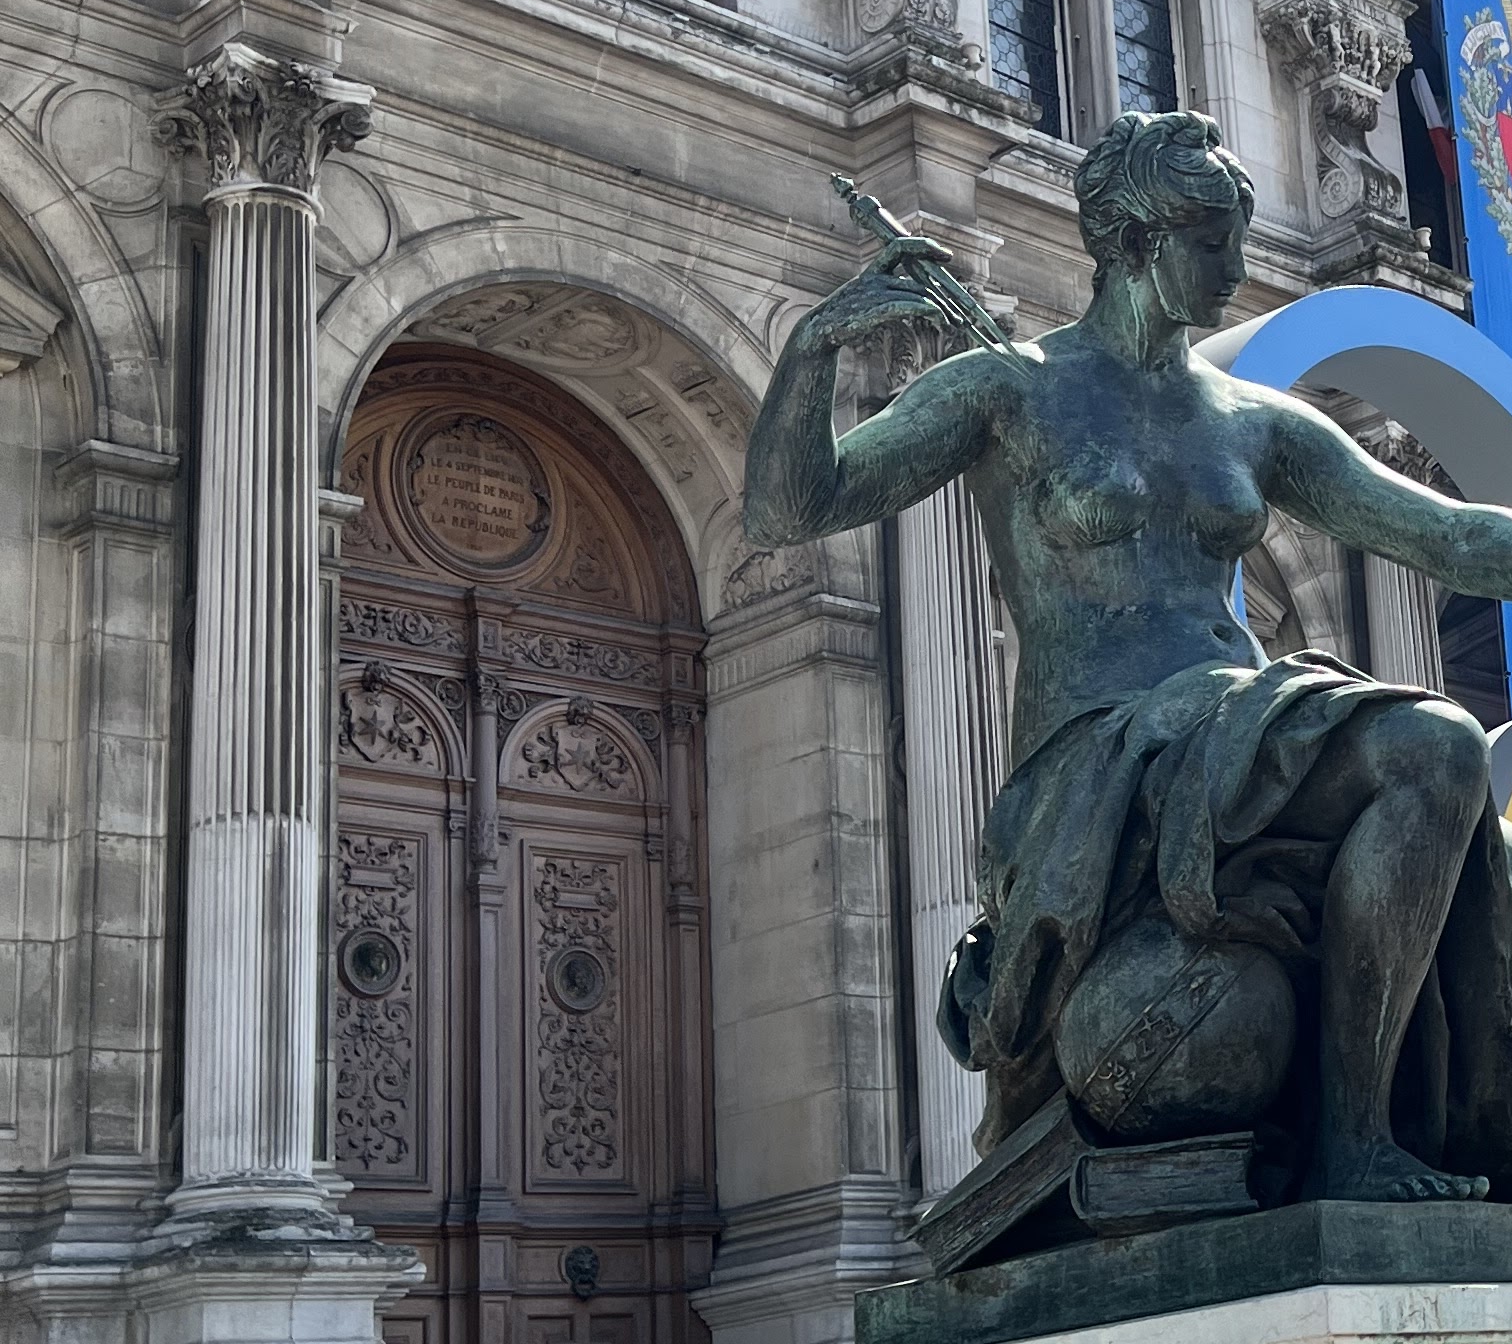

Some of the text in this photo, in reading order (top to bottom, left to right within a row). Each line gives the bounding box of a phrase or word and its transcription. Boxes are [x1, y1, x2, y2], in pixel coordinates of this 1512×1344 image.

[431, 457, 442, 468] LE
[428, 474, 525, 504] LE PEUPLE DE PARIS
[442, 496, 449, 506] A
[432, 512, 446, 524] LA
